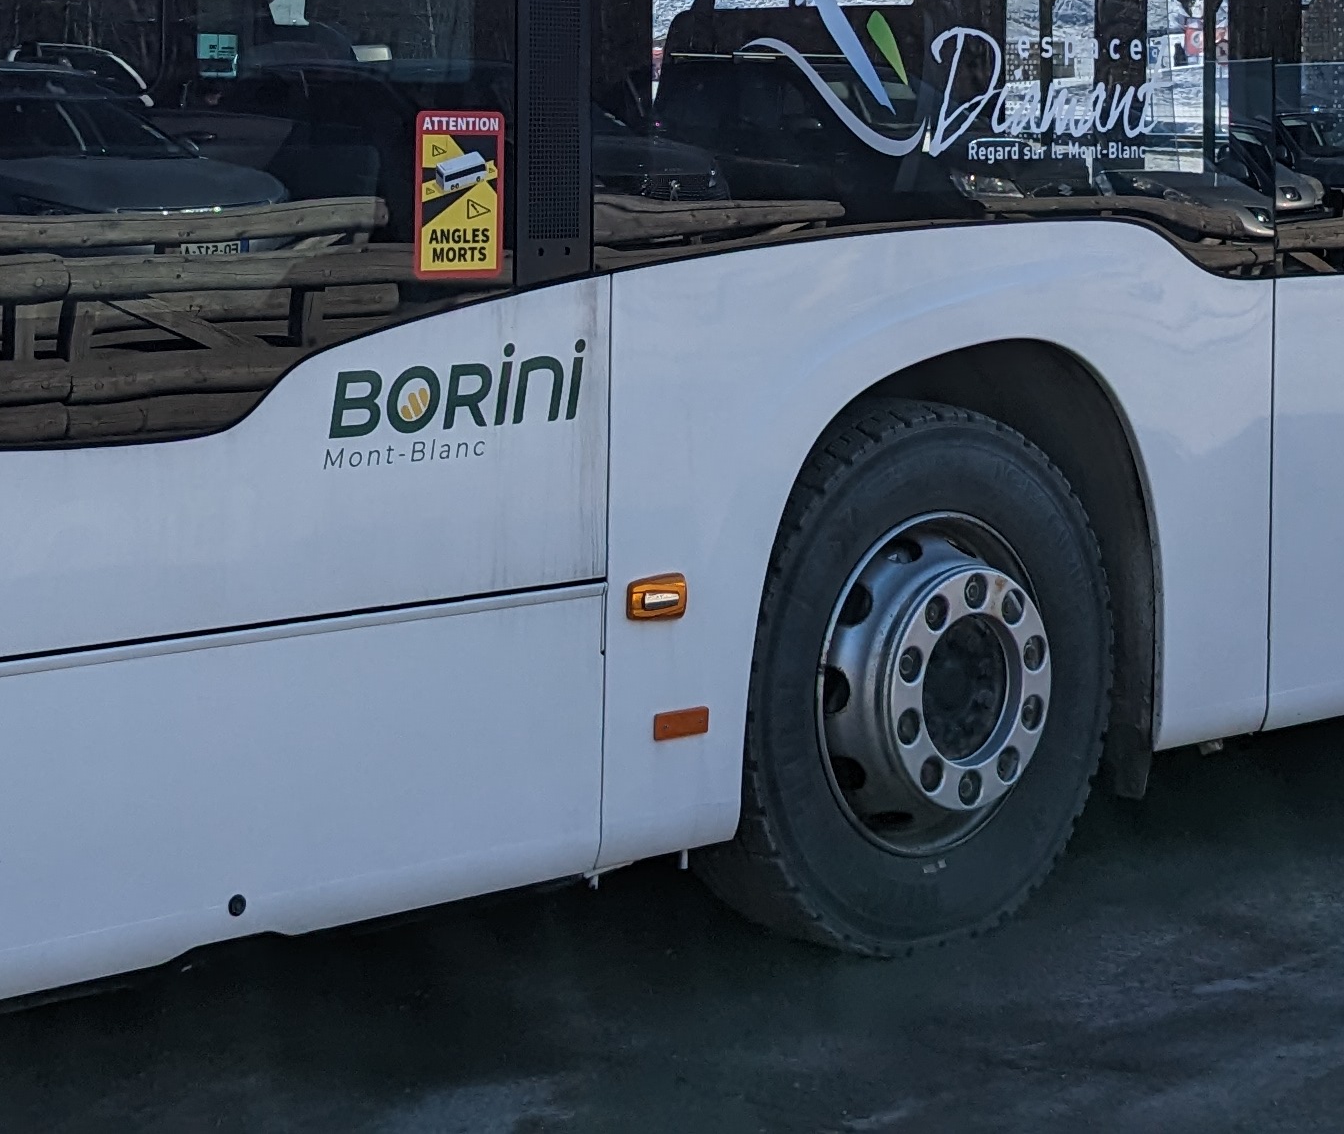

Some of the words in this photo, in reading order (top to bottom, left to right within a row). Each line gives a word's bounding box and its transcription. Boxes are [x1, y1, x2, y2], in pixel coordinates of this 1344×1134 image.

[1017, 36, 1143, 66] espace
[929, 26, 1173, 157] Diamant
[422, 116, 499, 131] ATTENTION
[968, 142, 1019, 164] Regard
[1023, 146, 1047, 160] sur
[1051, 142, 1064, 159] le
[1068, 141, 1146, 160] Mont-Blanc
[429, 228, 490, 245] ANGLES
[432, 246, 487, 263] MORTS
[323, 438, 486, 470] Mont-Blanc
